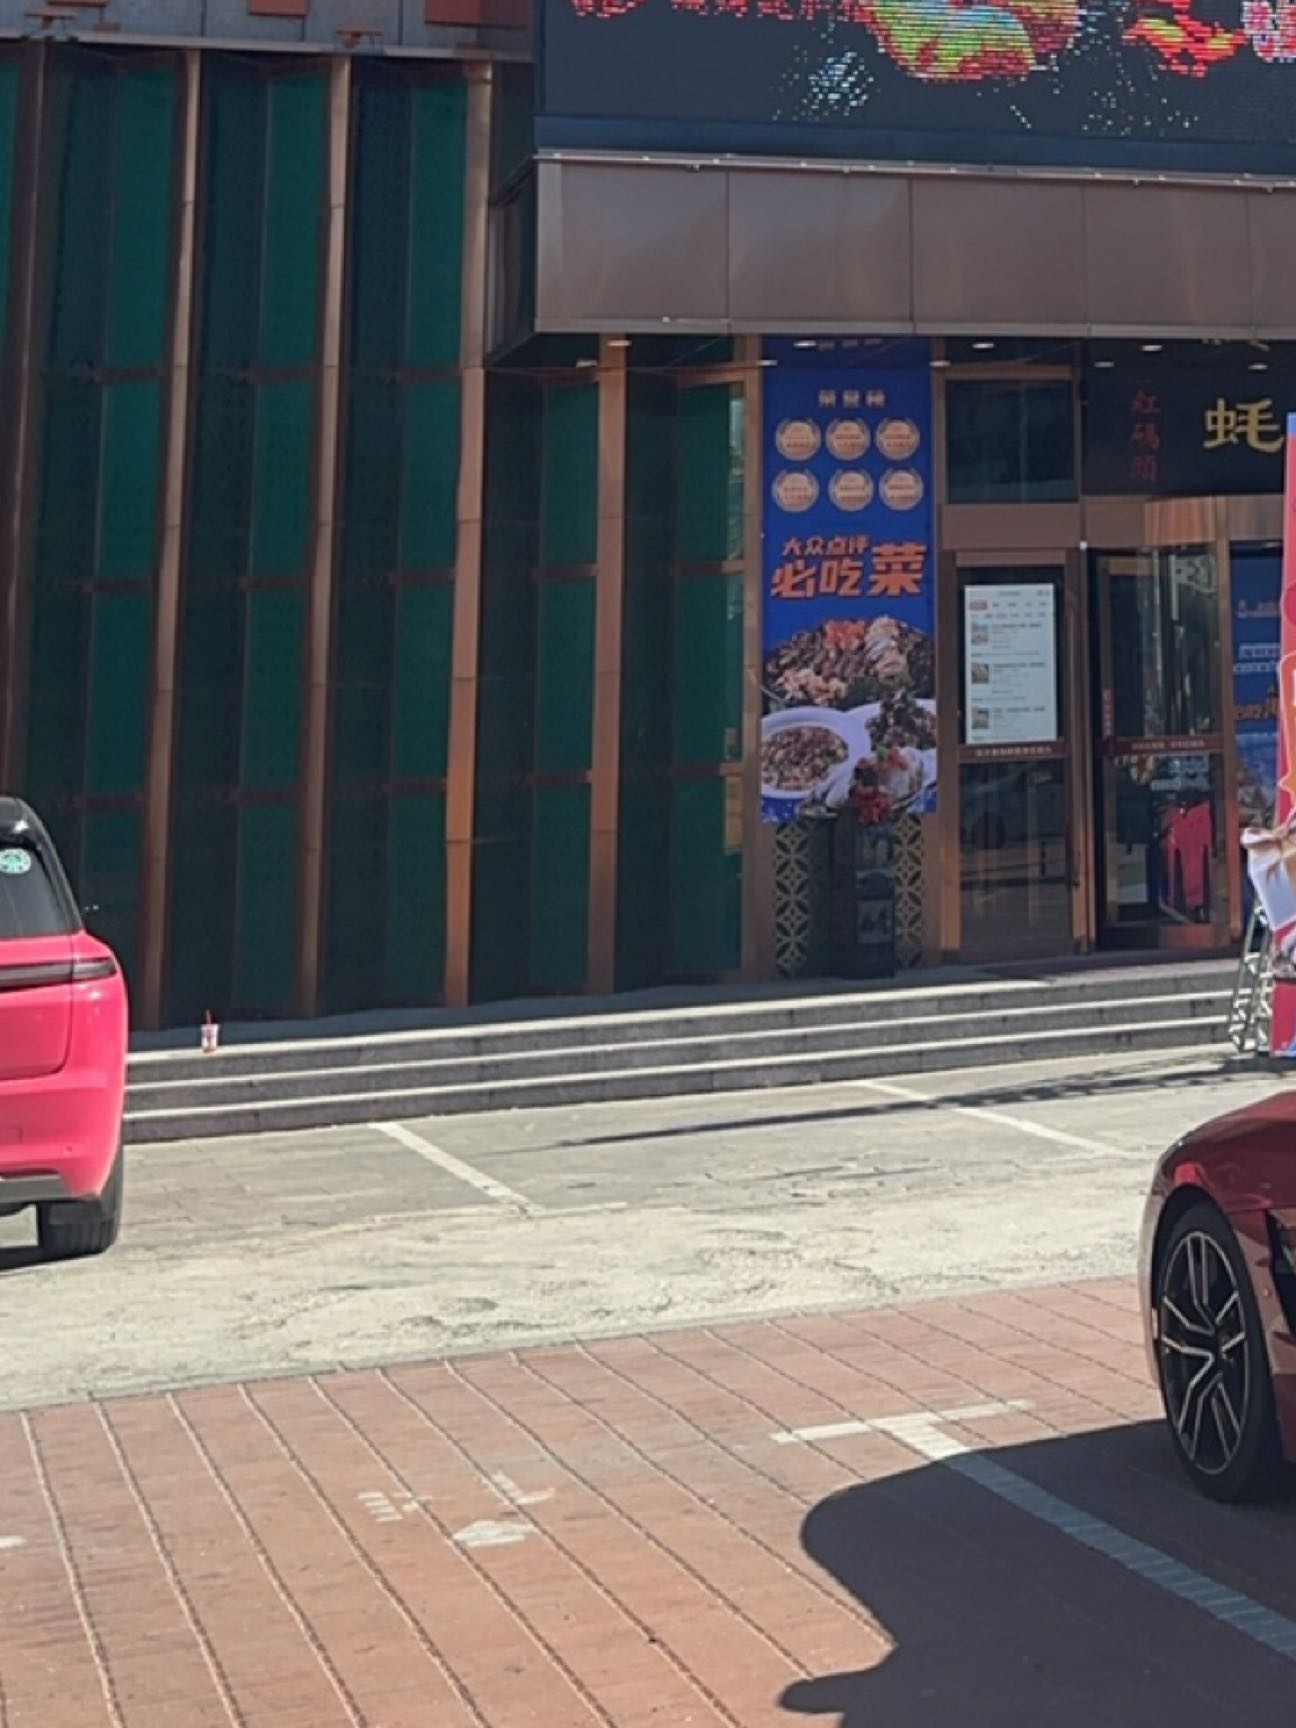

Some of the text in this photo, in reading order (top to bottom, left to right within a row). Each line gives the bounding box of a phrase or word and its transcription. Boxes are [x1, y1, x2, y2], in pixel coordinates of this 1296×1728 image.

[781, 534, 870, 557] 大众点评
[770, 539, 929, 600] 必吃菜
